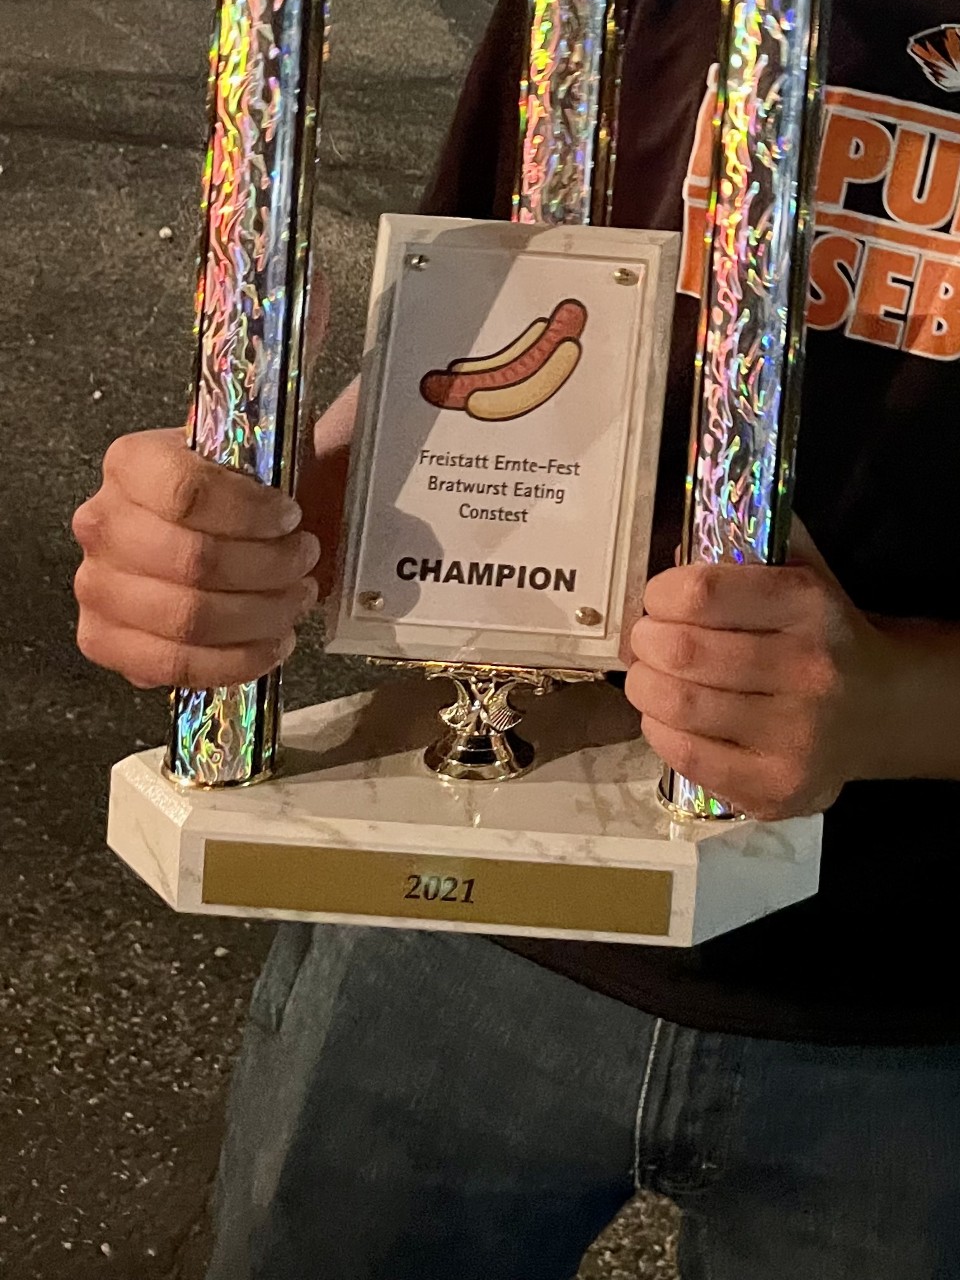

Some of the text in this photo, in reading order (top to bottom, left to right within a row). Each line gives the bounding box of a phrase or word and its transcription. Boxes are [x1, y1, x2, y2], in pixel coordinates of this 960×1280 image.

[418, 449, 581, 476] Freistatt Ernte-Fest
[427, 475, 565, 504] Bratwurst Eating
[459, 503, 529, 523] Constest
[396, 556, 577, 593] CHAMPION
[404, 874, 475, 903] 2021
